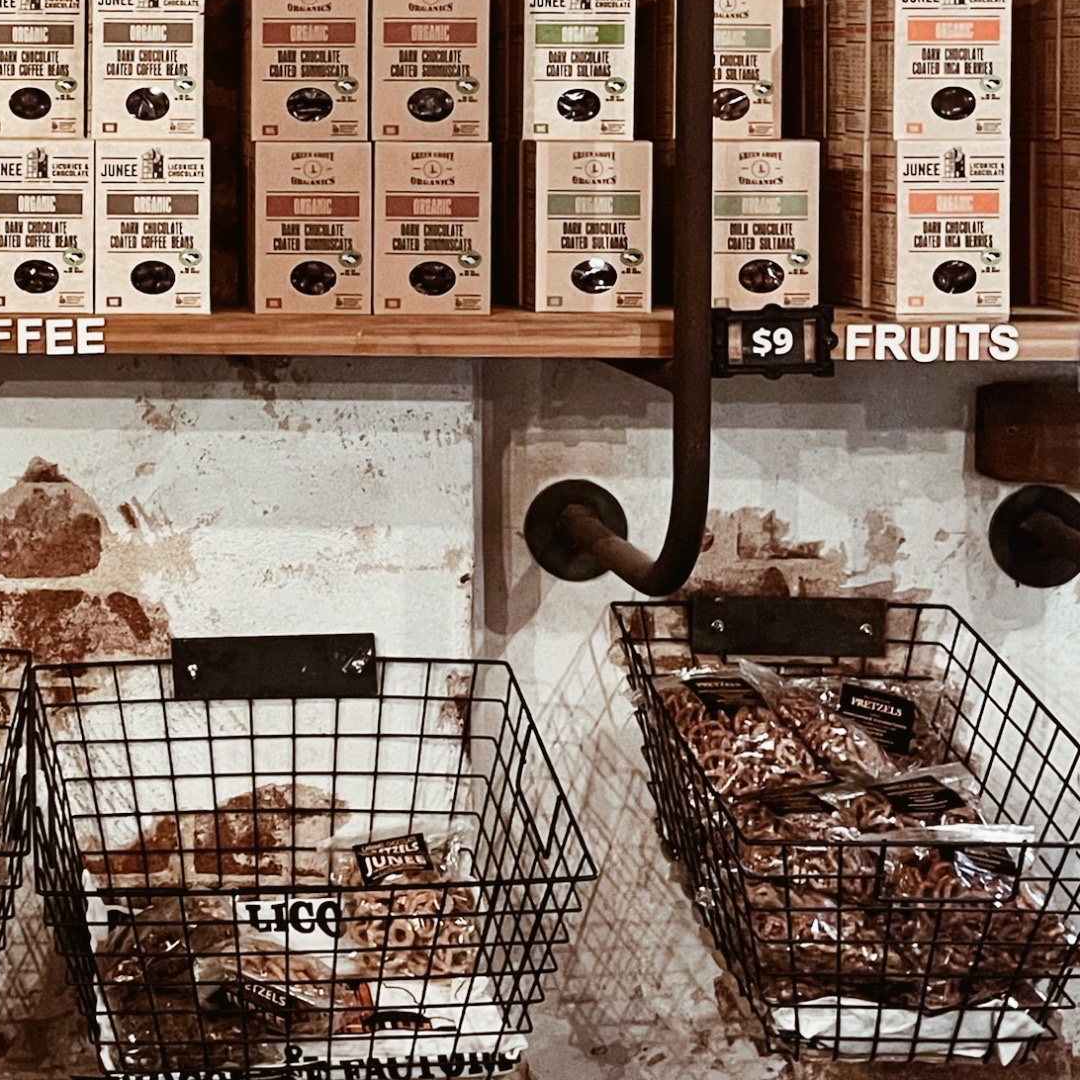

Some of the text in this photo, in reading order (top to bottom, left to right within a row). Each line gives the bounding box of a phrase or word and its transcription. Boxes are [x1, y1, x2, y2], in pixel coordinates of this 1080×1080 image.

[278, 50, 340, 63] DARK CHOCOLATE
[549, 51, 609, 63] DARK CHOCOLATE
[922, 48, 984, 60] DARK CHOCOLATE
[270, 65, 296, 77] COATED
[547, 65, 611, 77] COATED SULTANAS
[913, 62, 993, 75] COATED INCA BERRIES
[101, 164, 137, 177] JUNEE
[903, 163, 940, 176] JUNEE
[5, 222, 66, 234] DARK CHOCOLATE
[25, 235, 51, 248] COFFEE
[55, 236, 77, 248] BEANS
[752, 327, 793, 357] $9
[846, 324, 1019, 362] FRUITS
[851, 697, 902, 717] PRETZELS
